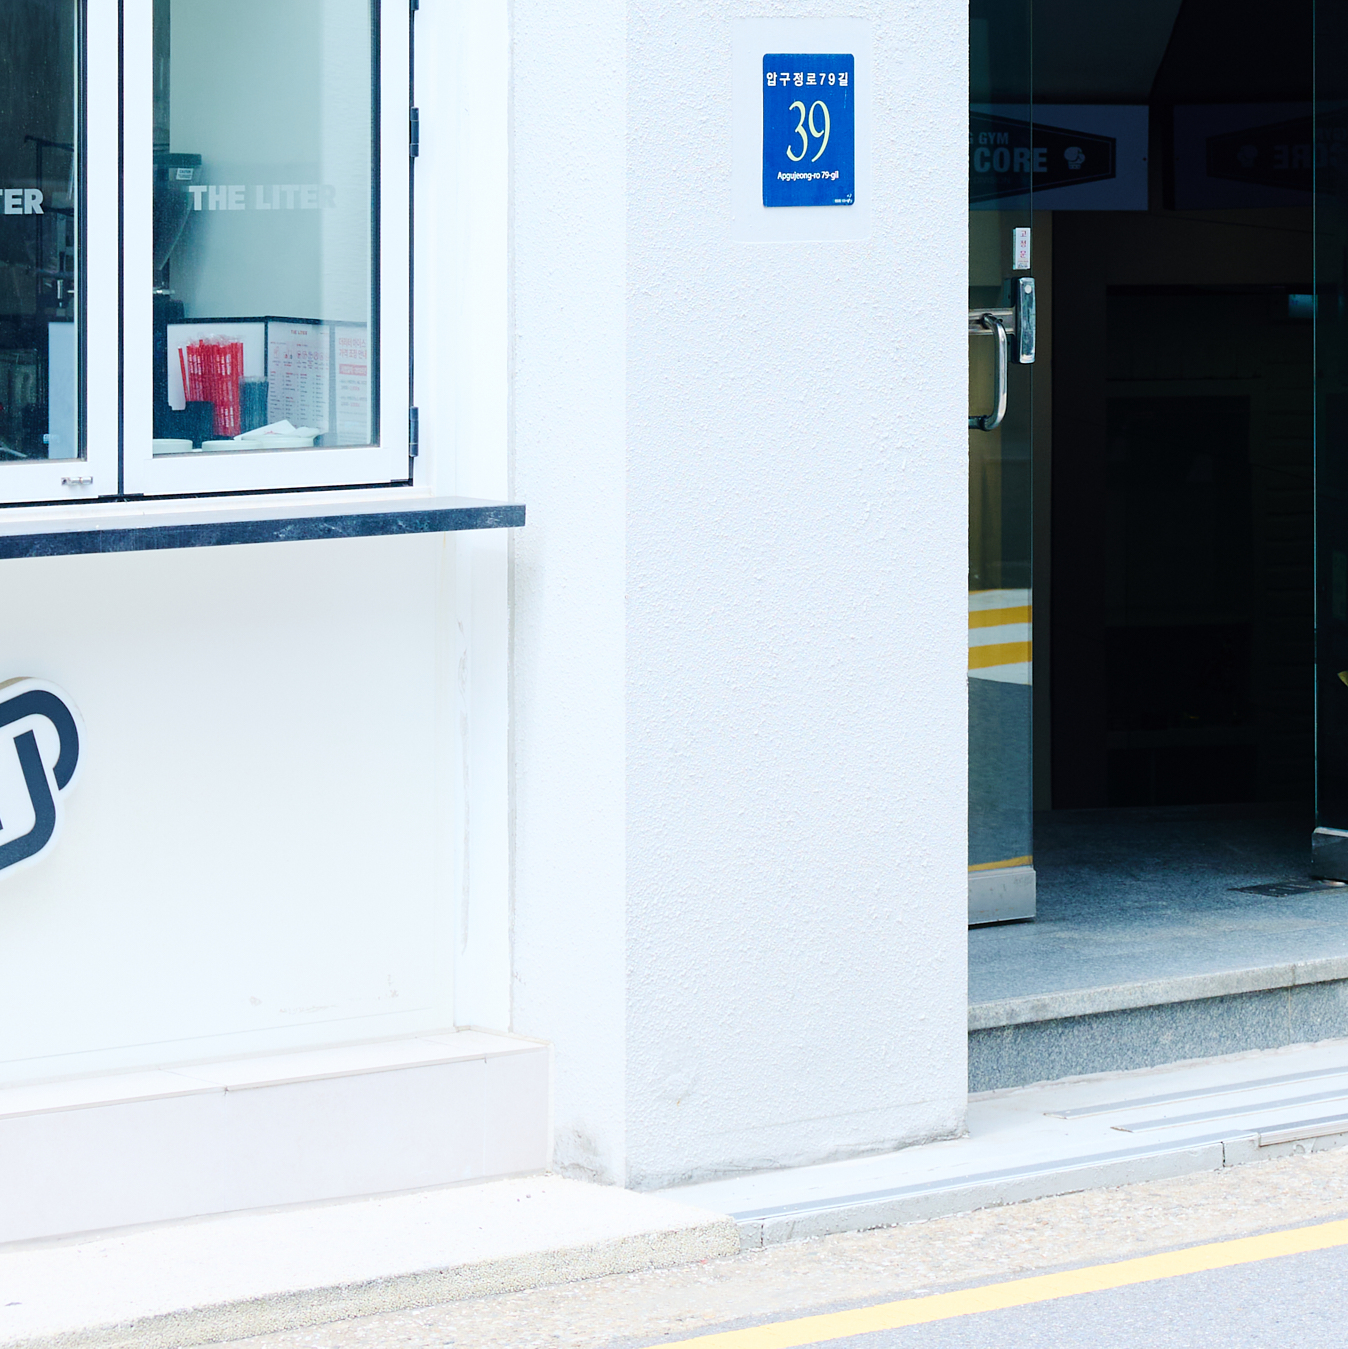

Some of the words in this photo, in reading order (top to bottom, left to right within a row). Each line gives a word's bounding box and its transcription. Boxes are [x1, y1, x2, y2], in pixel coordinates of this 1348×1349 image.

[766, 72, 849, 87] 압구정로79길
[786, 100, 831, 162] 39
[978, 132, 1009, 145] GYM
[973, 147, 1048, 173] CORE
[777, 171, 820, 181] Apgujeong-ro
[821, 170, 839, 180] 79-gil
[0, 188, 44, 214] ER
[189, 185, 245, 210] THE
[256, 184, 337, 209] LITER
